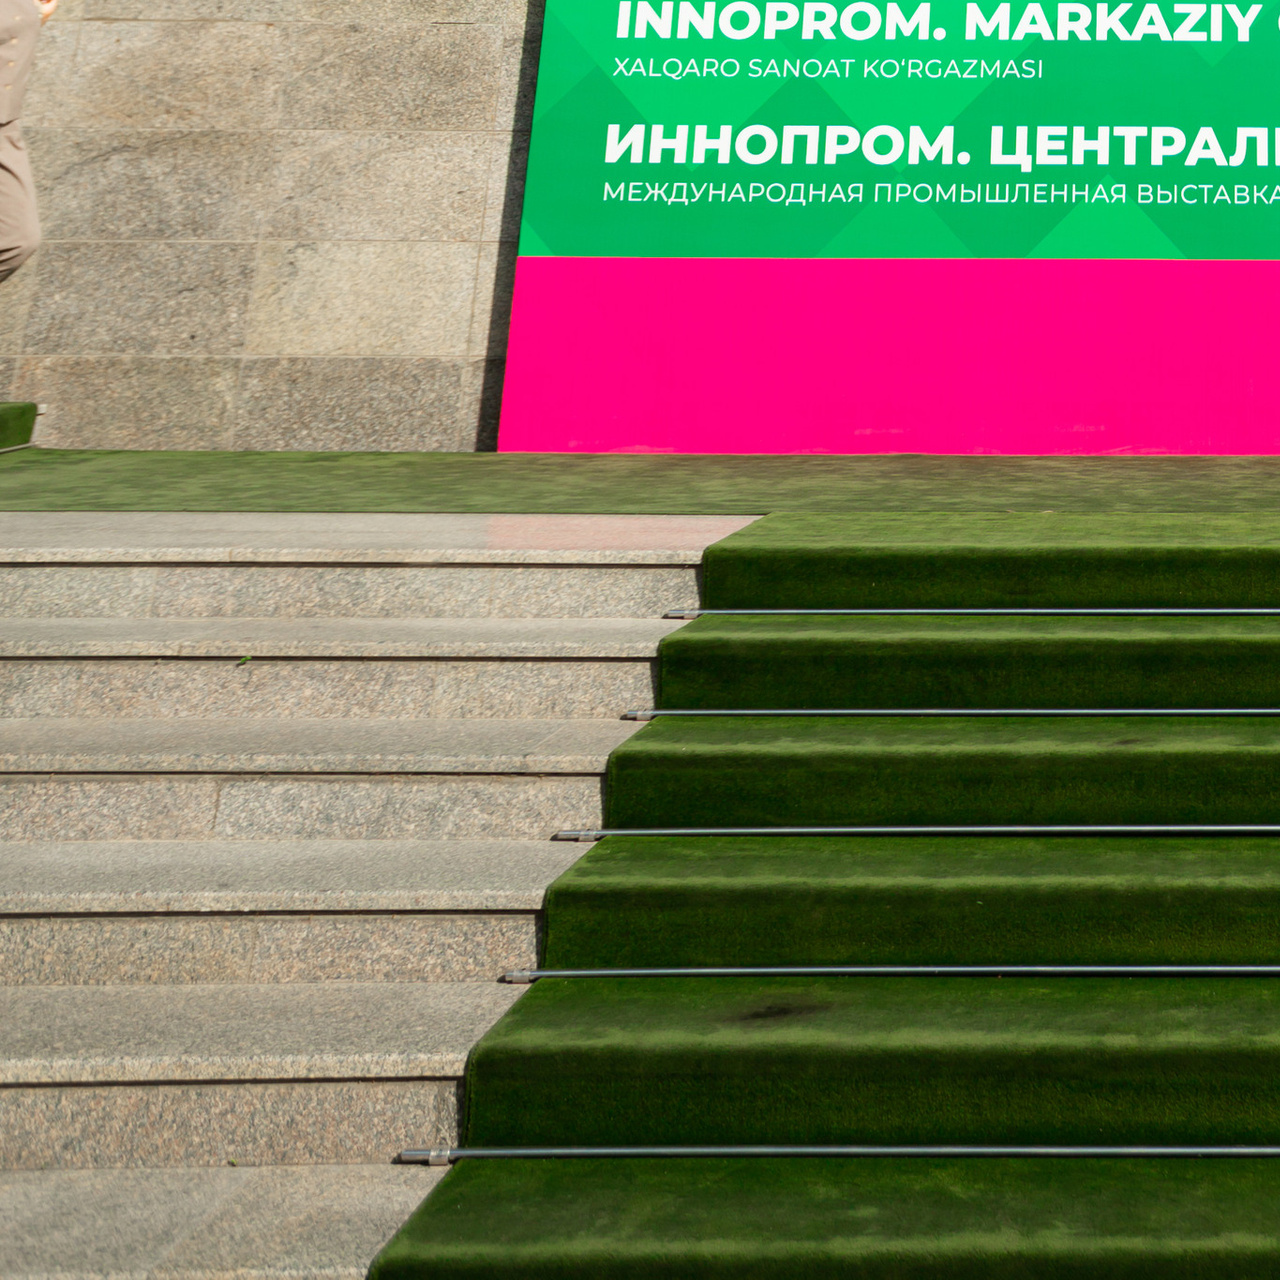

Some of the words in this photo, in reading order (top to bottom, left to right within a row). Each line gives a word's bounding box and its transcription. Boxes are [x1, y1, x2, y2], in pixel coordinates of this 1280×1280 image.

[616, 0, 947, 42] INNOPROM.
[964, 2, 1263, 43] MARKAZIY
[612, 57, 740, 81] XALQARO
[748, 58, 856, 78] SANOAT
[863, 57, 1043, 80] KO‘RGAZMASI
[604, 123, 971, 166] ИННОПРОМ.
[603, 181, 864, 207] МЕЖДУНАРОДНАЯ
[874, 183, 1126, 205] ПРОМЫШЛЕННАЯ
